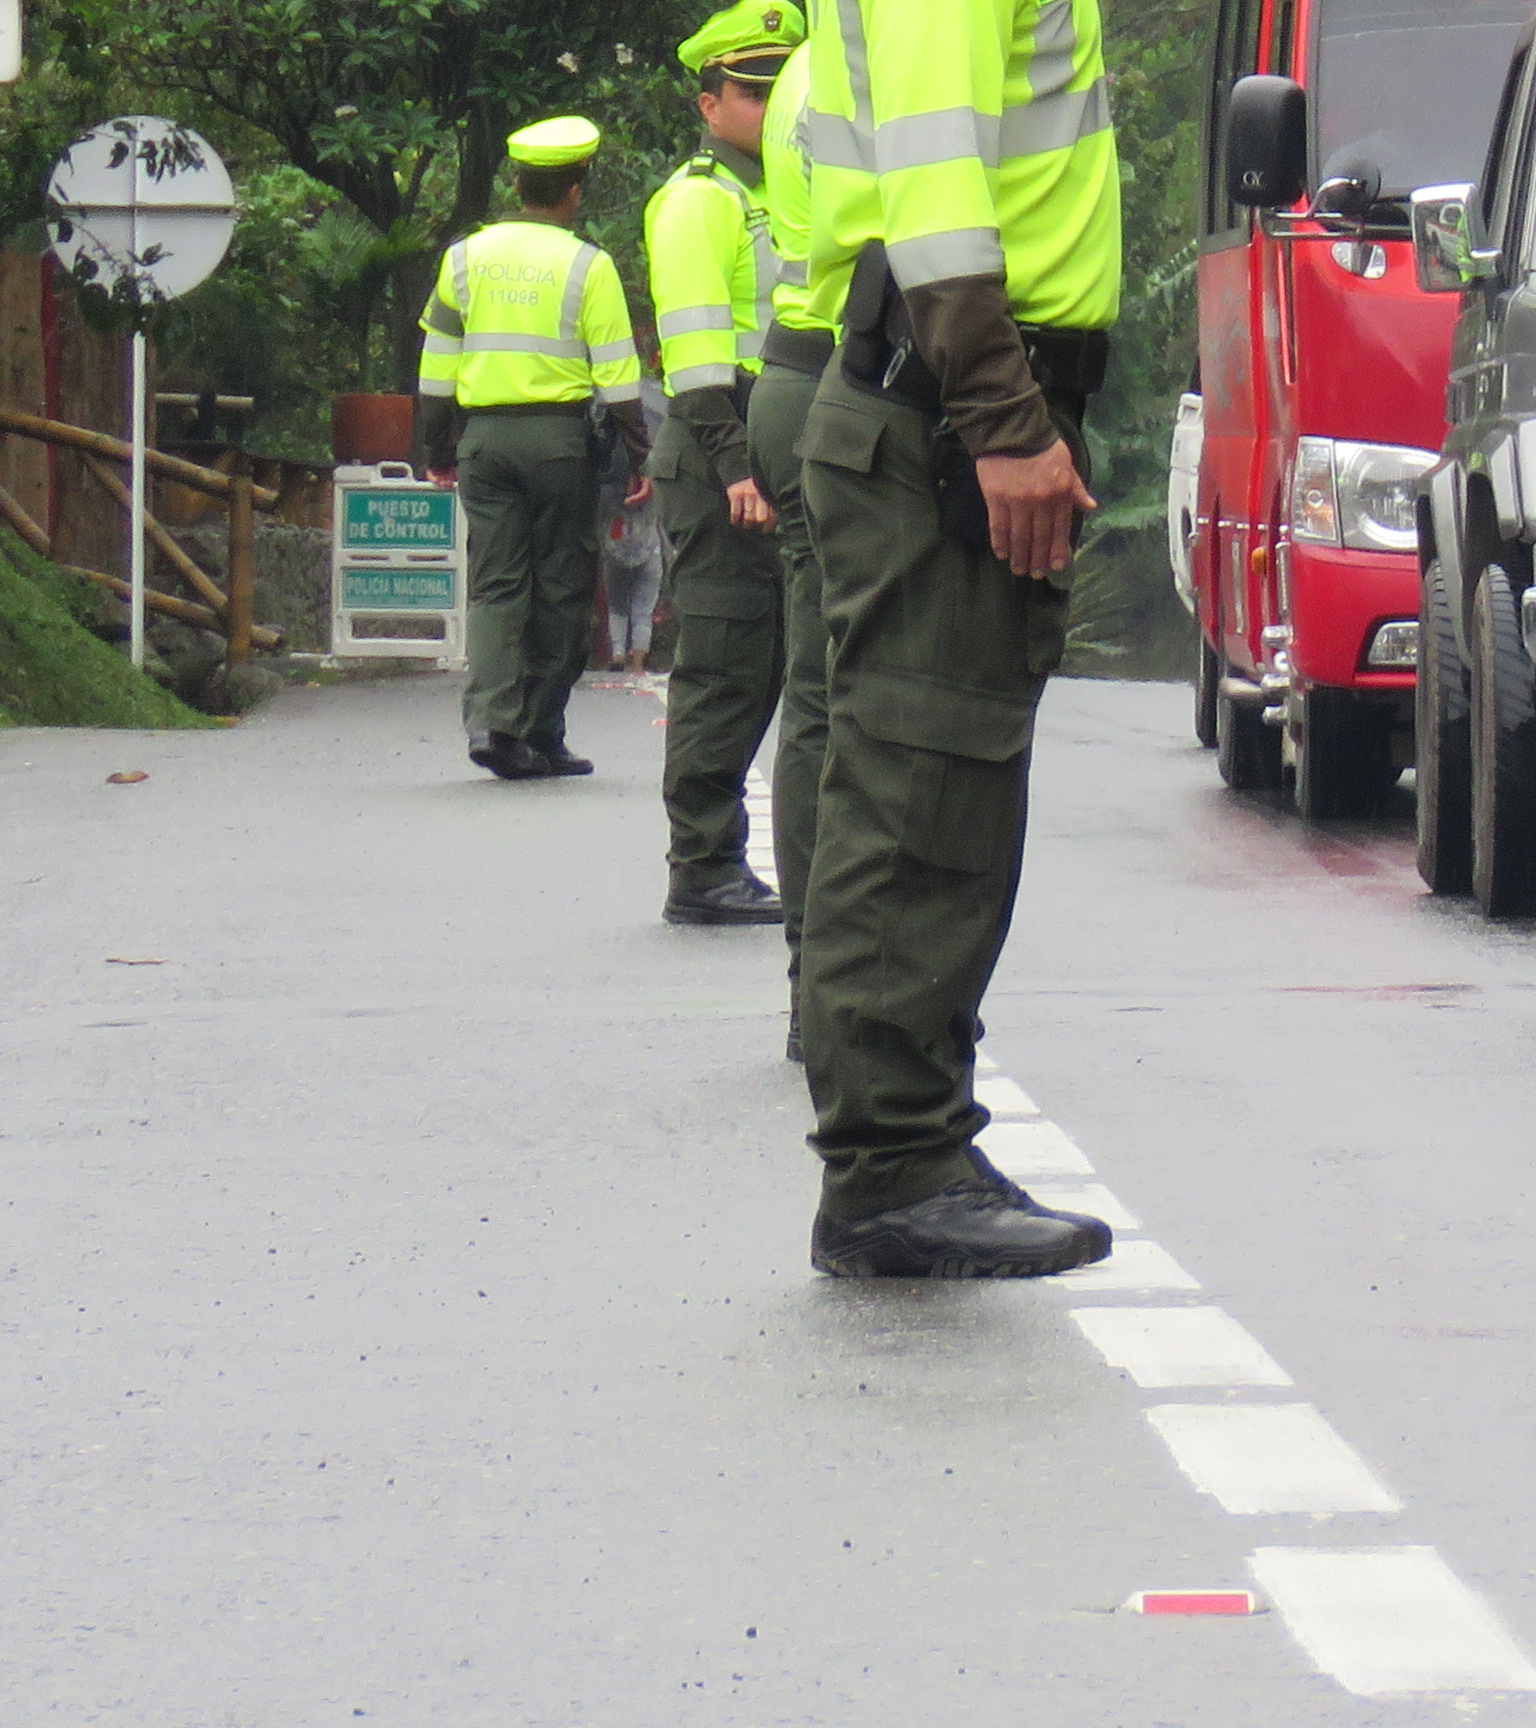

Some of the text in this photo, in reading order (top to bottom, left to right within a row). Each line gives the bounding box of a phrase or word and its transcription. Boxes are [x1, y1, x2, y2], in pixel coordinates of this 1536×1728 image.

[473, 262, 556, 287] POLICIA
[367, 500, 431, 519] PUESTO
[350, 522, 449, 540] DE CONTROL
